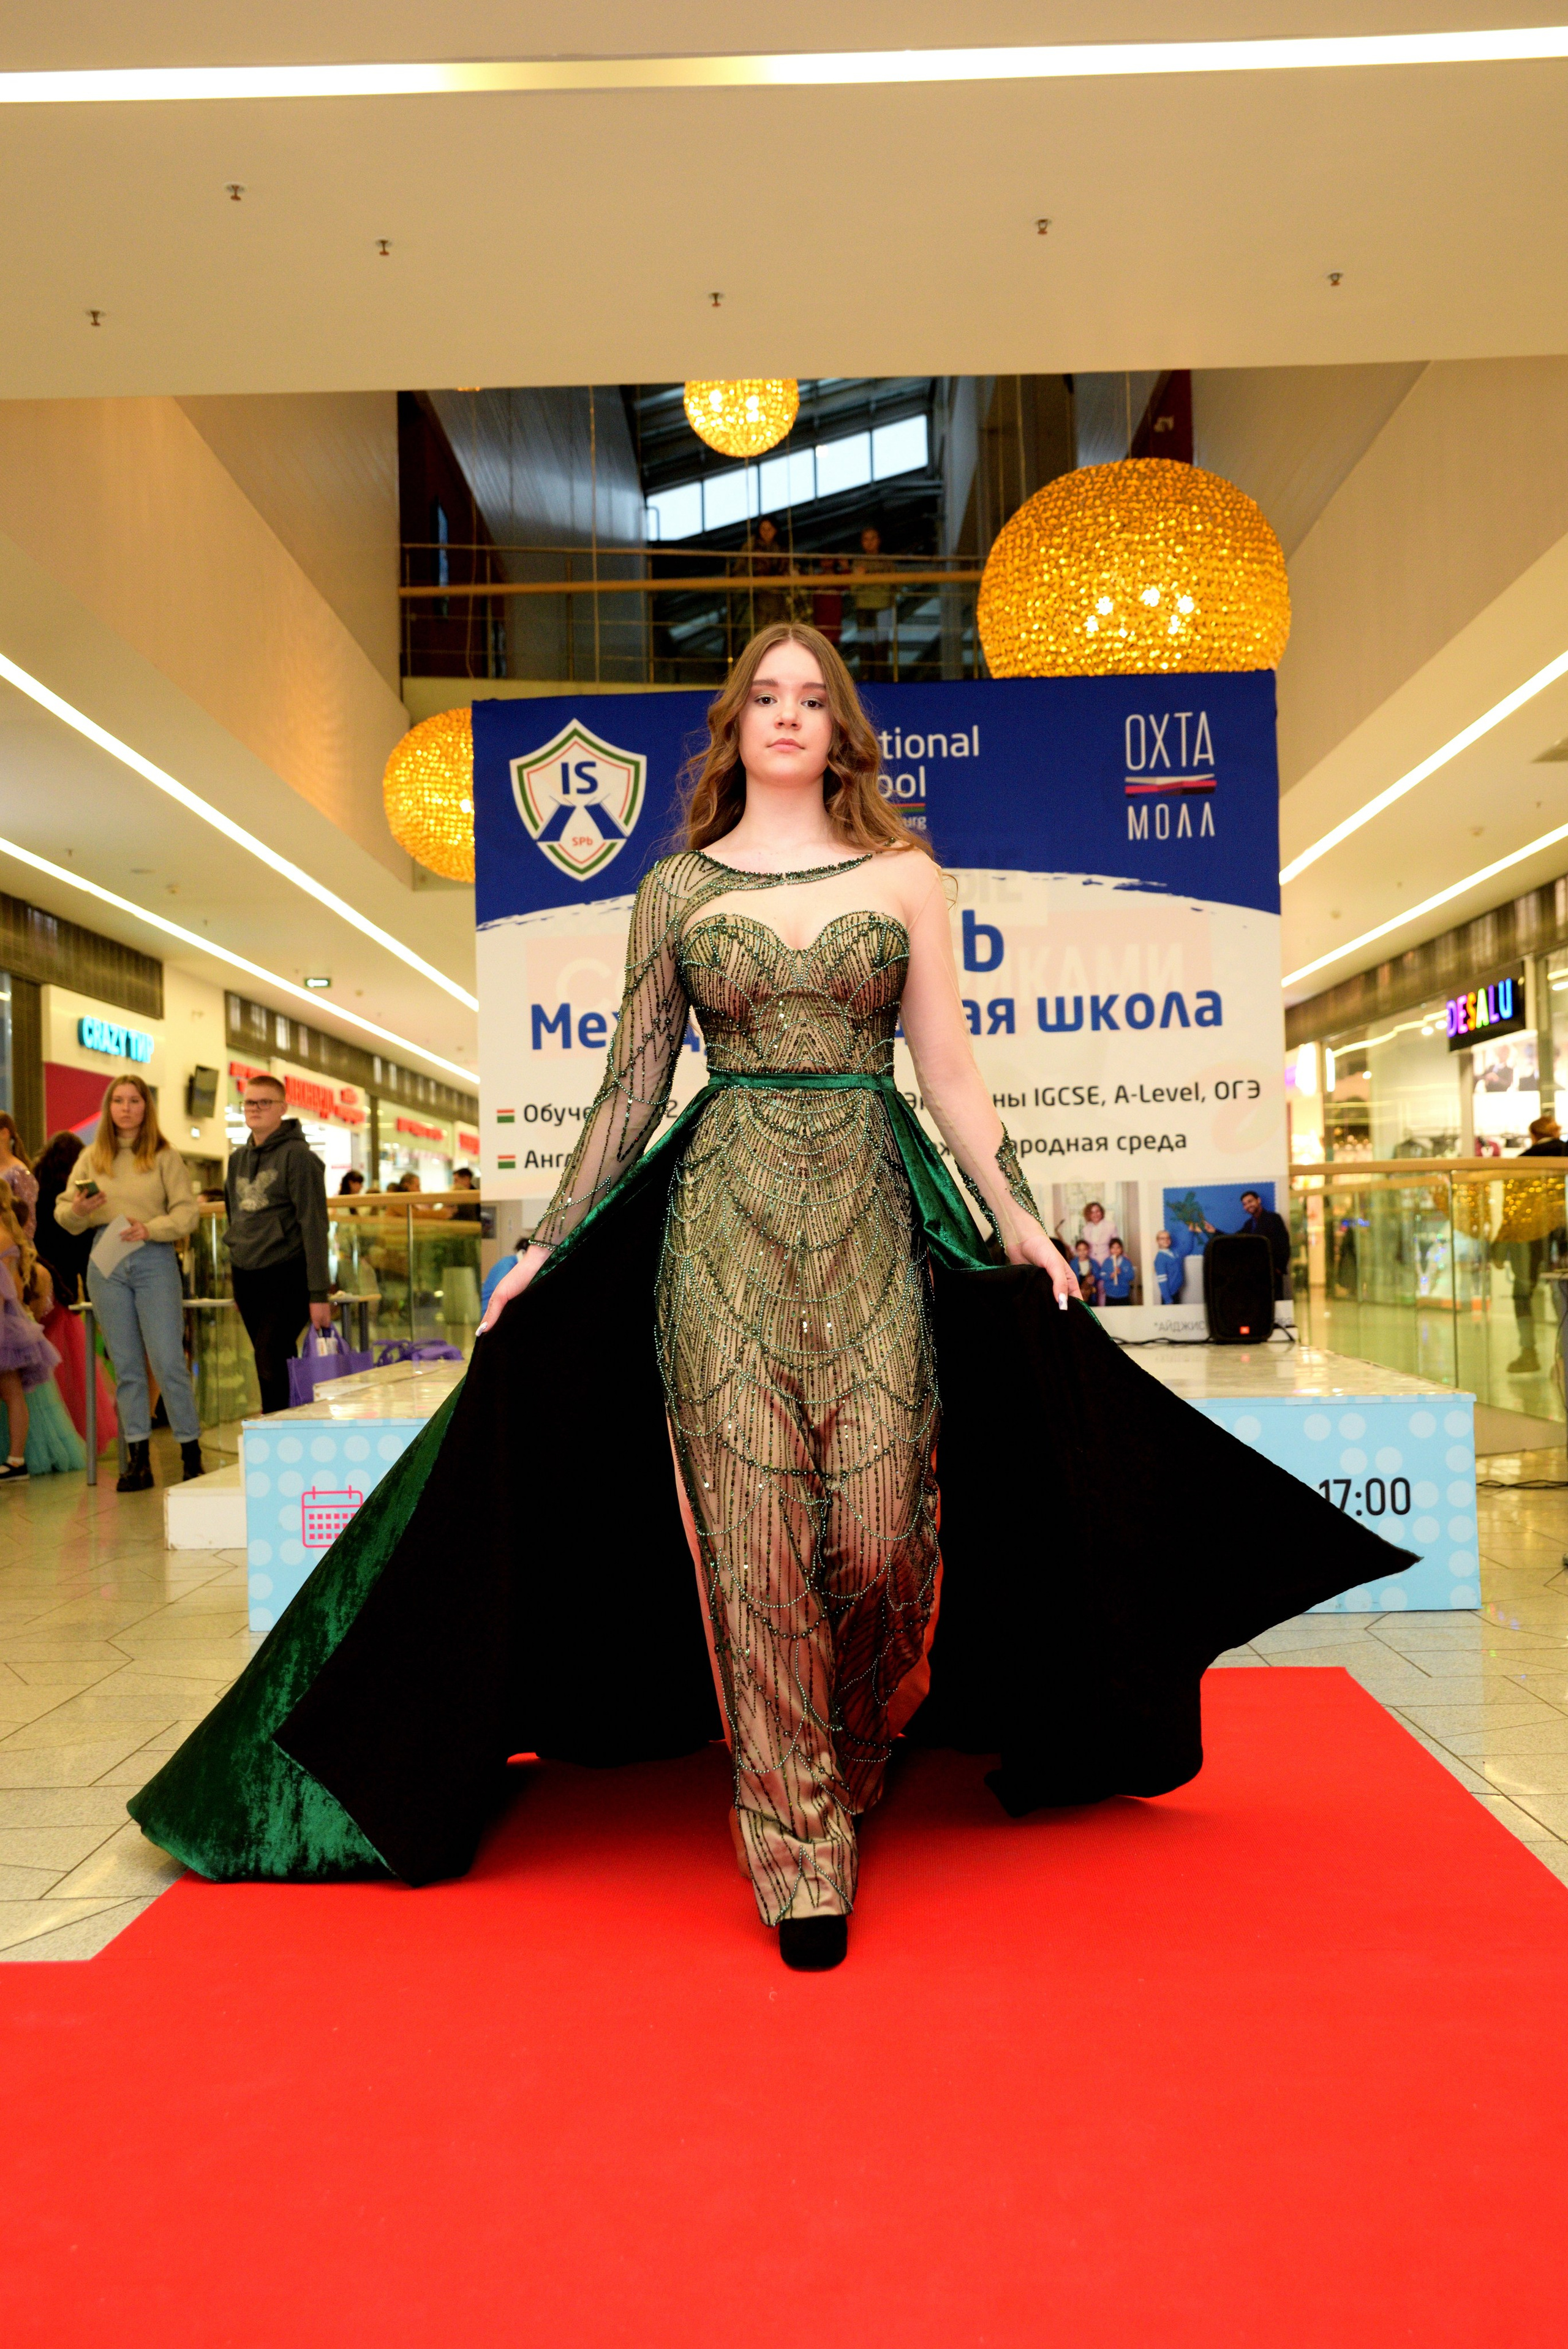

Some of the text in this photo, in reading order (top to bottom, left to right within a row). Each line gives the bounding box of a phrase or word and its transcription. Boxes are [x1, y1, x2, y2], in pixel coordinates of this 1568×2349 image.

[878, 725, 979, 760] tional
[1125, 711, 1215, 771] ОХТА
[560, 761, 598, 795] IS
[877, 765, 926, 799] ool
[1127, 801, 1216, 841] МОЛЛ
[571, 836, 594, 846] SPb
[962, 908, 1005, 973] b
[530, 1003, 619, 1050] Ме
[961, 997, 1016, 1035] ая
[1037, 990, 1223, 1033] школа
[1446, 977, 1513, 1038] DESALU
[81, 1015, 128, 1057] CRAZY
[993, 1092, 1027, 1108] ны
[1035, 1085, 1107, 1107] IGCSE,
[1114, 1081, 1207, 1104] A-Level,
[1215, 1079, 1261, 1101] ОГЭ
[1117, 1133, 1187, 1155] среда
[1319, 1477, 1411, 1516] 17:00
